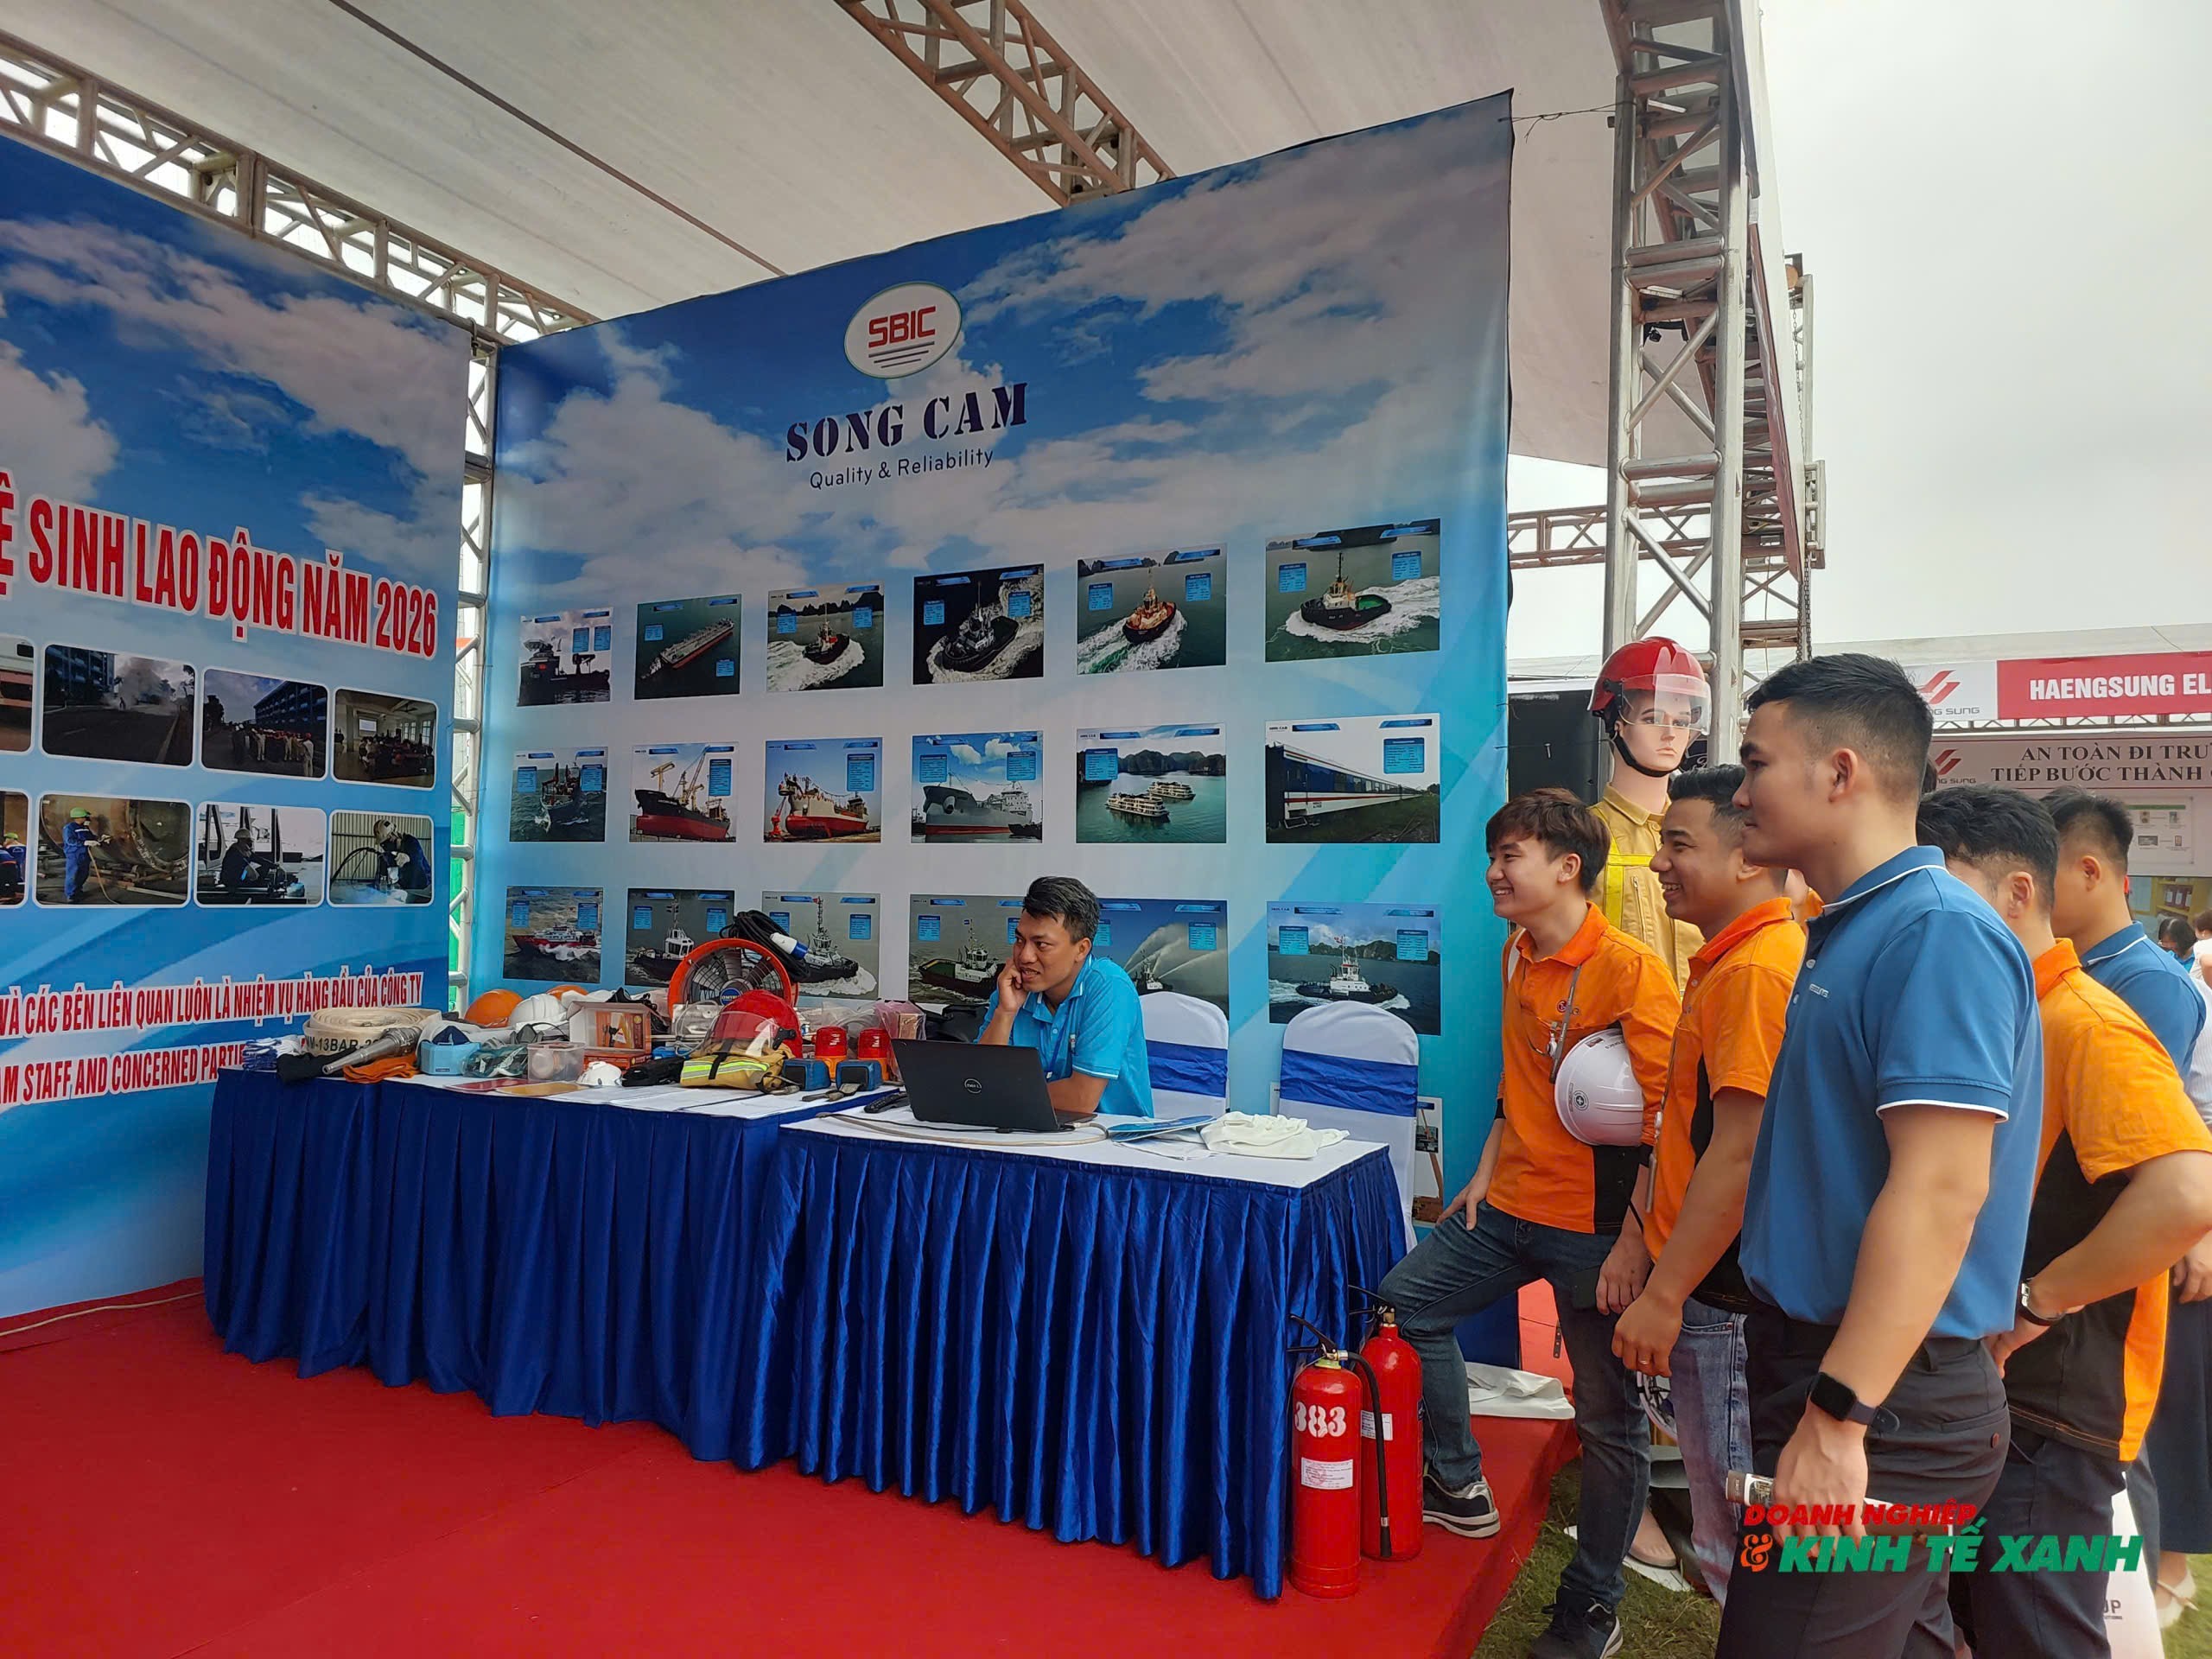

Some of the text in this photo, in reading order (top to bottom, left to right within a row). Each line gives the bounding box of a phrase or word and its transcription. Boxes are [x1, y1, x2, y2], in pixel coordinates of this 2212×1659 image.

[868, 306, 936, 348] SBIC
[786, 383, 1028, 463] SONG CAM
[810, 448, 994, 490] Quality & Reliability
[29, 499, 124, 597] SINH
[136, 523, 199, 611] LAO
[209, 532, 294, 638] ĐỘNG
[303, 554, 368, 643] NĂM
[376, 582, 437, 658] 2026
[2031, 674, 2175, 701] HAENGSUNG
[1991, 763, 2202, 782] TIẾP BƯỚC THÀNH
[2021, 747, 2051, 761] AN
[2057, 742, 2121, 761] TOÀN
[2129, 746, 2152, 760] ĐI
[25, 988, 58, 1034] CÁC
[62, 986, 94, 1031] BÊN
[99, 984, 132, 1028] LIÊN
[136, 988, 174, 1029] QUAN
[177, 980, 212, 1022] LUÔN
[215, 979, 231, 1020] LÀ
[233, 976, 275, 1024] NHIỆM
[278, 982, 294, 1021] VỤ
[296, 974, 328, 1012] HÀNG
[332, 968, 354, 1008] ĐẦU
[357, 966, 378, 1007] CỦA
[380, 969, 406, 1006] CÔNG
[410, 974, 422, 1004] TY
[23, 1059, 73, 1102] STAFF
[75, 1057, 108, 1095] AND
[111, 1051, 198, 1091] CONCERNED
